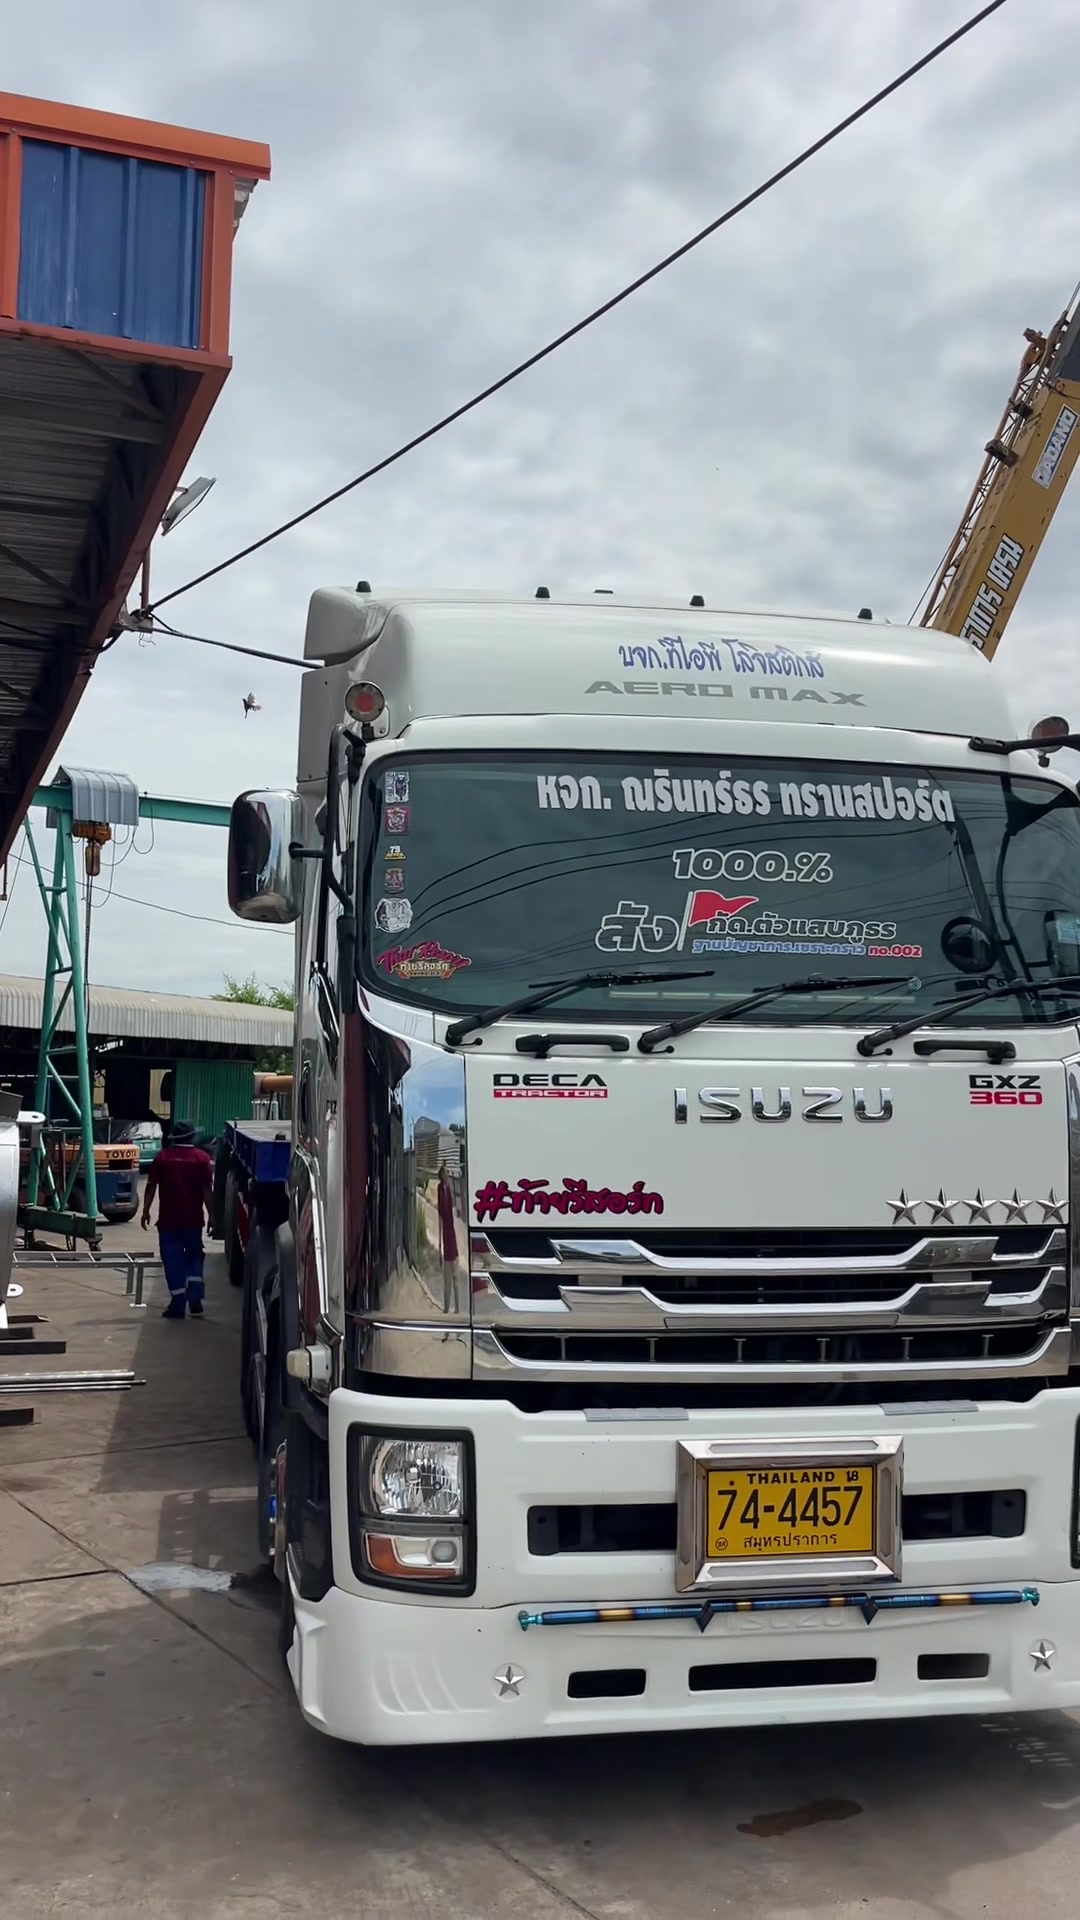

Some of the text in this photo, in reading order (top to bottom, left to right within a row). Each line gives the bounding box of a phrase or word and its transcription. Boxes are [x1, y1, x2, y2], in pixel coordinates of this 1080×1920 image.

[584, 680, 867, 707] AERO MAX
[536, 775, 612, 809] หจก.
[779, 776, 956, 822] ทรานสปอร์ต
[672, 848, 833, 883] 1000.%
[867, 944, 923, 958] no.002
[493, 1074, 607, 1087] DECA
[969, 1075, 1041, 1089] GXZ
[495, 1089, 606, 1098] TRACTOR
[969, 1091, 1042, 1105] 360
[674, 1086, 893, 1124] ISUZU
[747, 1471, 859, 1484] THAILAND 18
[717, 1485, 863, 1530] 74-4457
[744, 1532, 838, 1551] สมุทรปราการ
